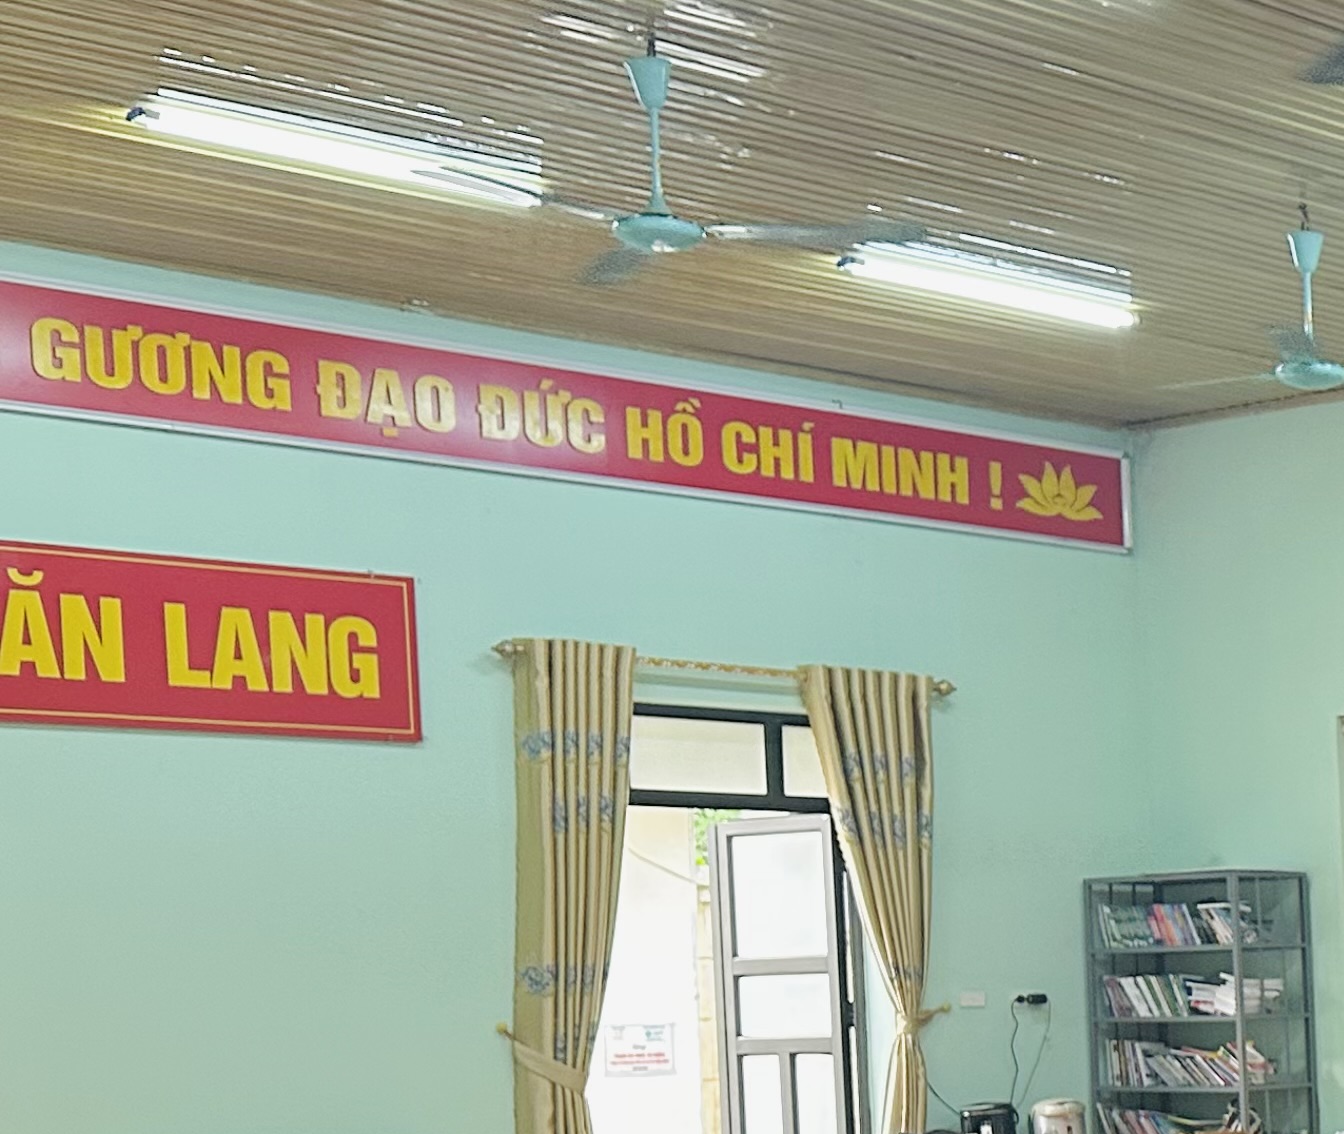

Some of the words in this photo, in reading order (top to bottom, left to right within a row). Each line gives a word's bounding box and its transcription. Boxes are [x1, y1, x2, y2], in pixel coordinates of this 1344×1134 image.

[30, 317, 293, 412] GƯƠNG
[316, 359, 458, 437] ĐẠO
[477, 379, 607, 455] ĐỨC
[625, 397, 705, 467] HỒ
[721, 420, 815, 484] CHÍ
[831, 437, 970, 505] MINH
[0, 567, 126, 683] ĂN
[163, 602, 381, 699] LANG
